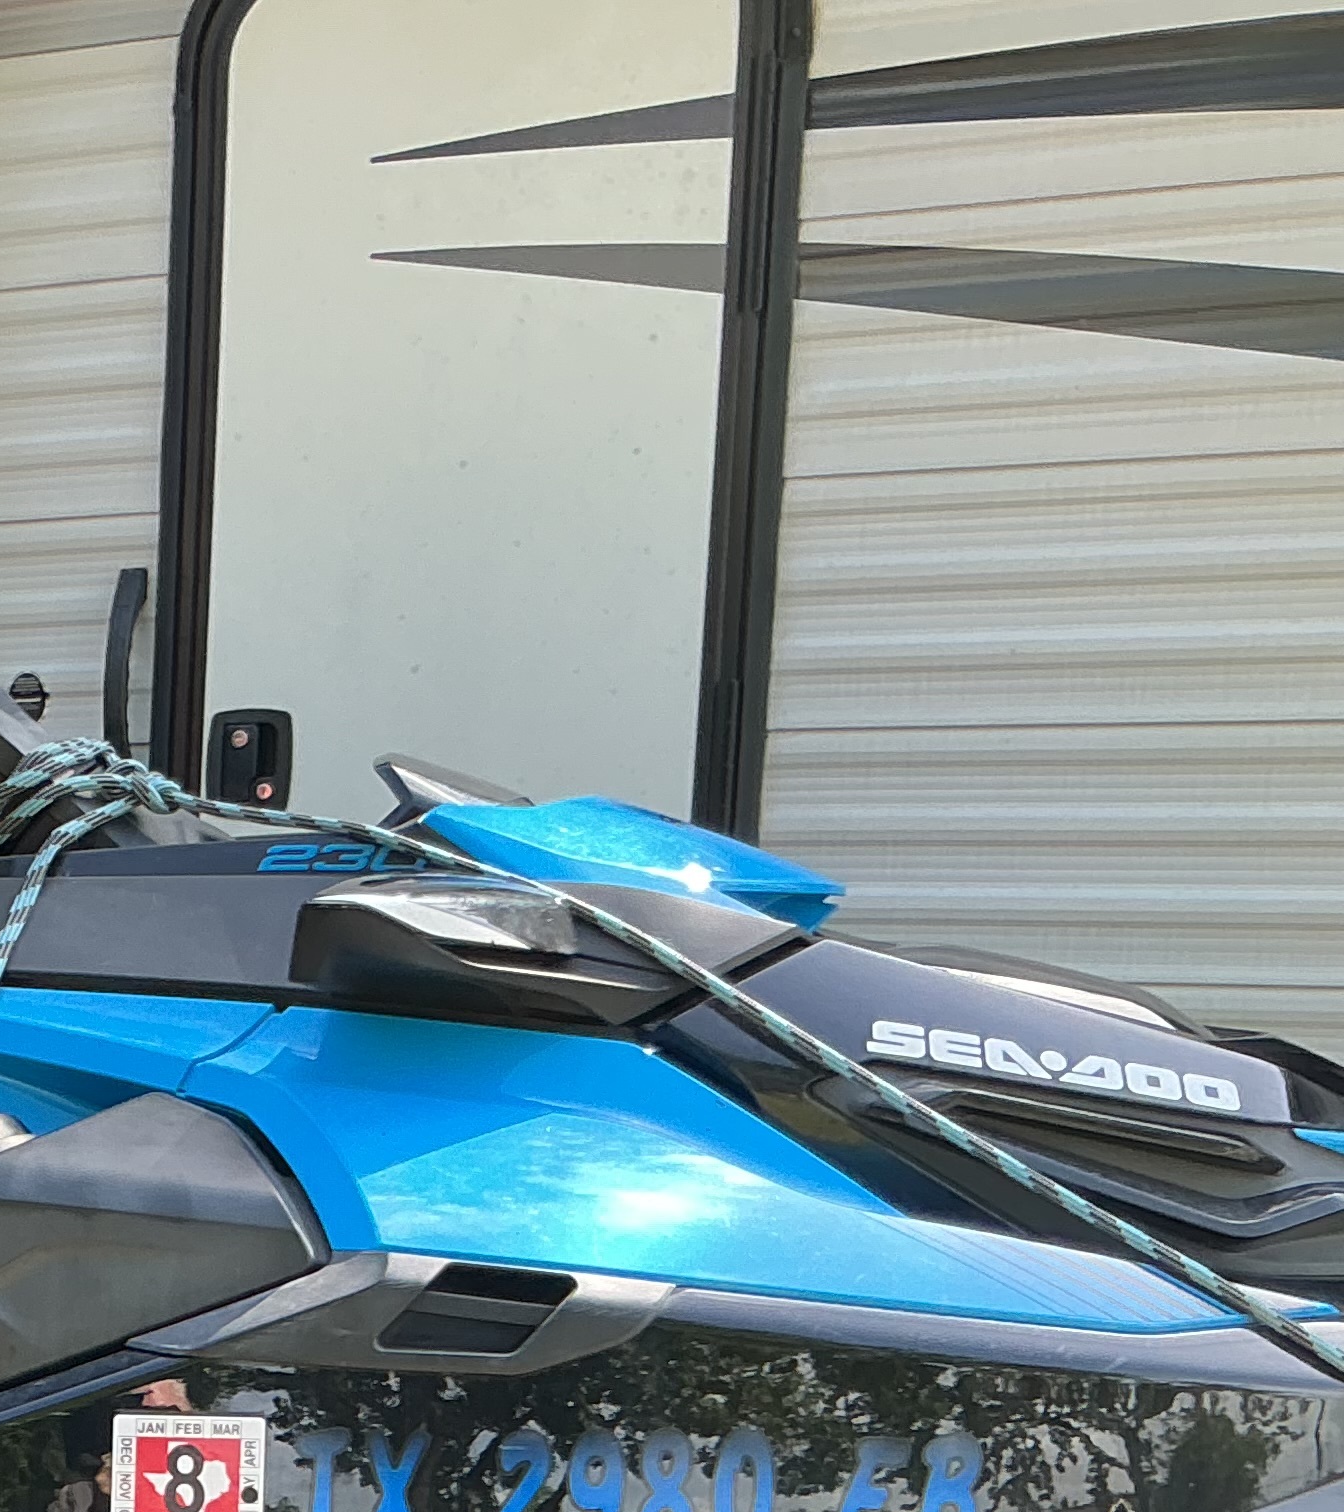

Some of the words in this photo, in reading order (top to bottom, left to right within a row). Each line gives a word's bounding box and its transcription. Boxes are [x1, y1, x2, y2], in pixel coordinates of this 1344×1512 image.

[137, 1422, 165, 1434] JAN
[175, 1423, 202, 1435] FEB
[212, 1423, 240, 1436] MAR
[120, 1437, 132, 1465] DEC
[243, 1440, 256, 1468] APR
[119, 1473, 131, 1500] NOV
